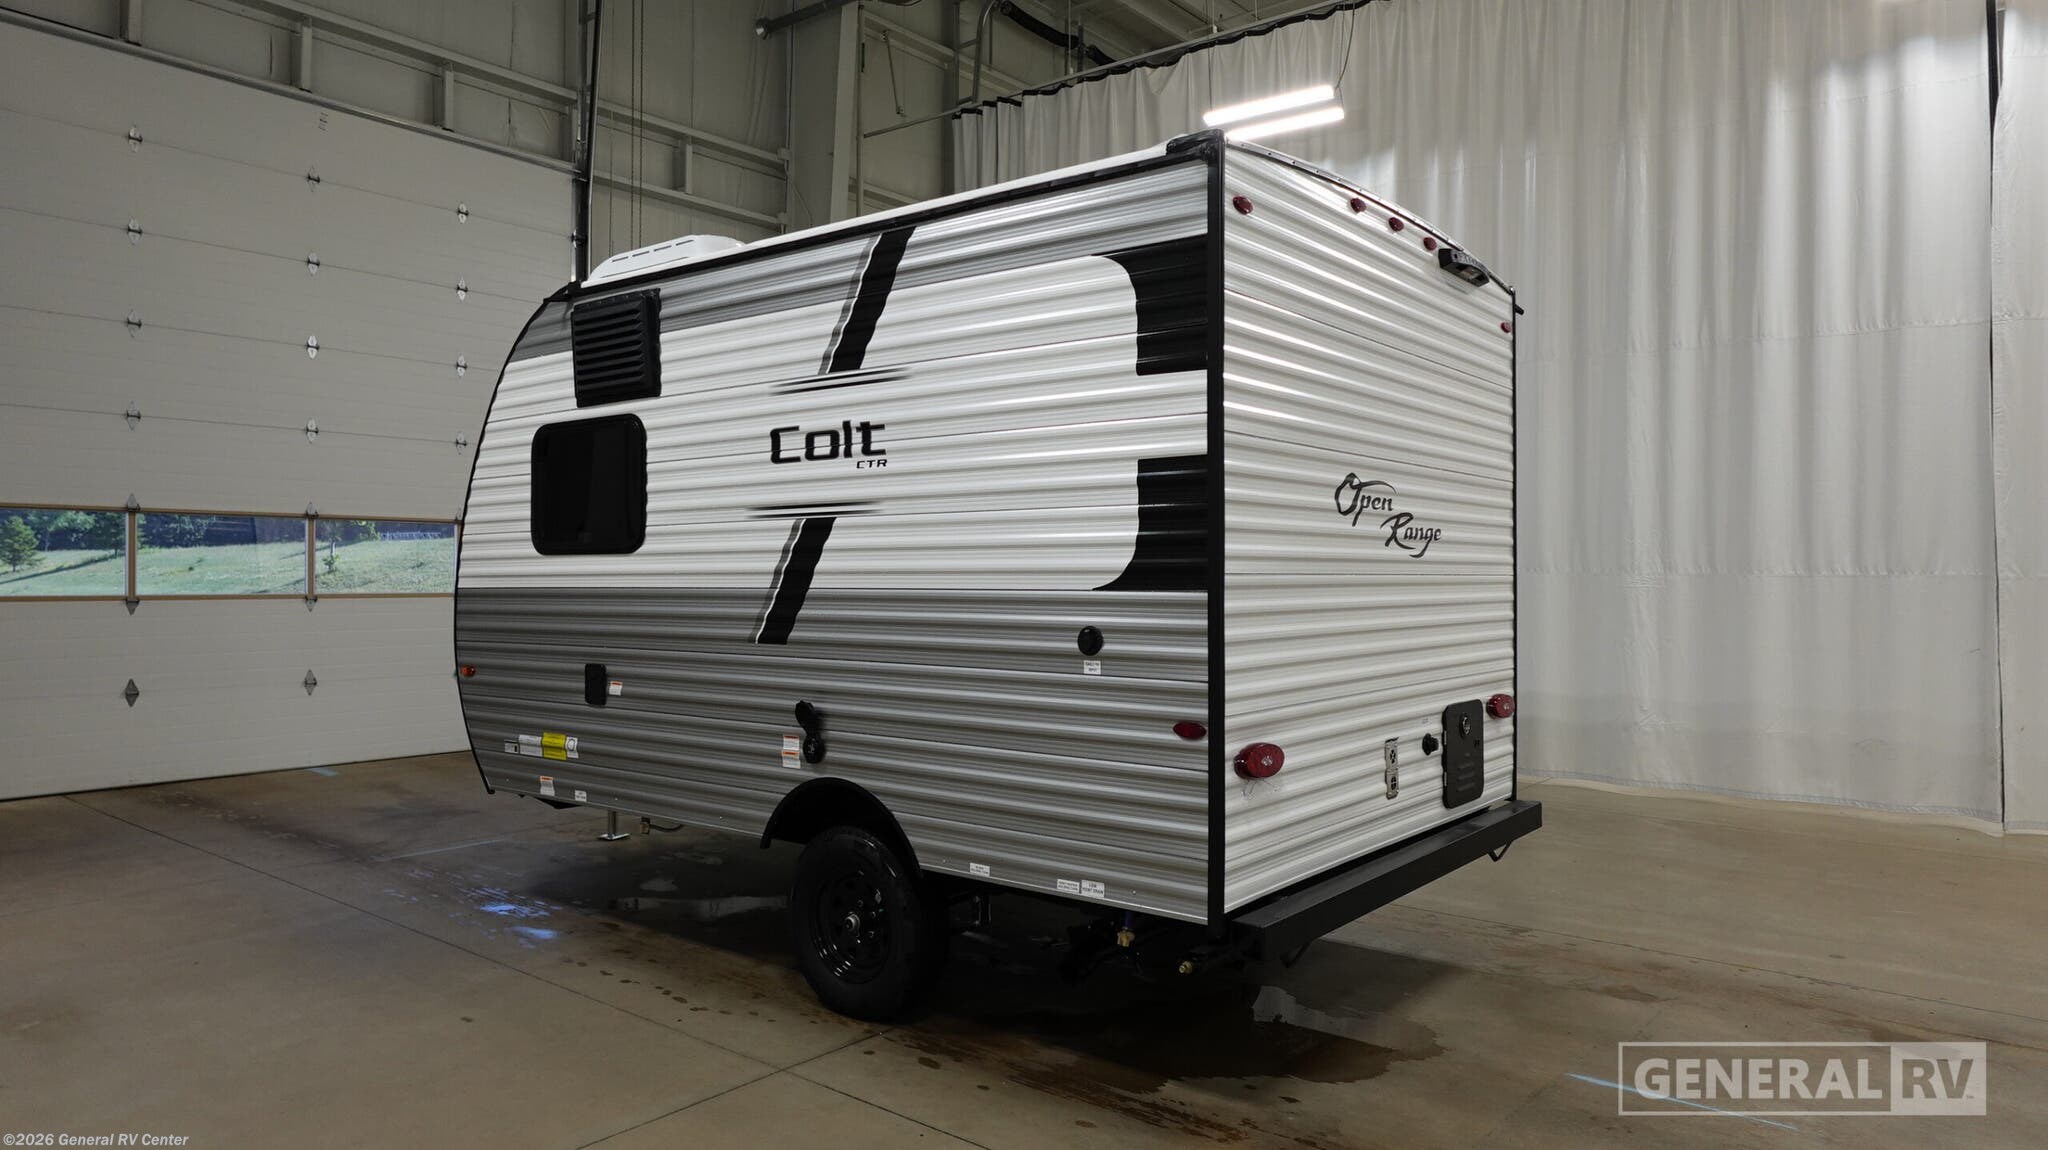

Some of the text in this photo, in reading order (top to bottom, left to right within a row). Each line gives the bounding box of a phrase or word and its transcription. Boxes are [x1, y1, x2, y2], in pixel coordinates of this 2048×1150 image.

[770, 420, 886, 464] Colt
[856, 459, 888, 469] CTR
[1334, 472, 1399, 527] Open
[1380, 512, 1441, 558] Range
